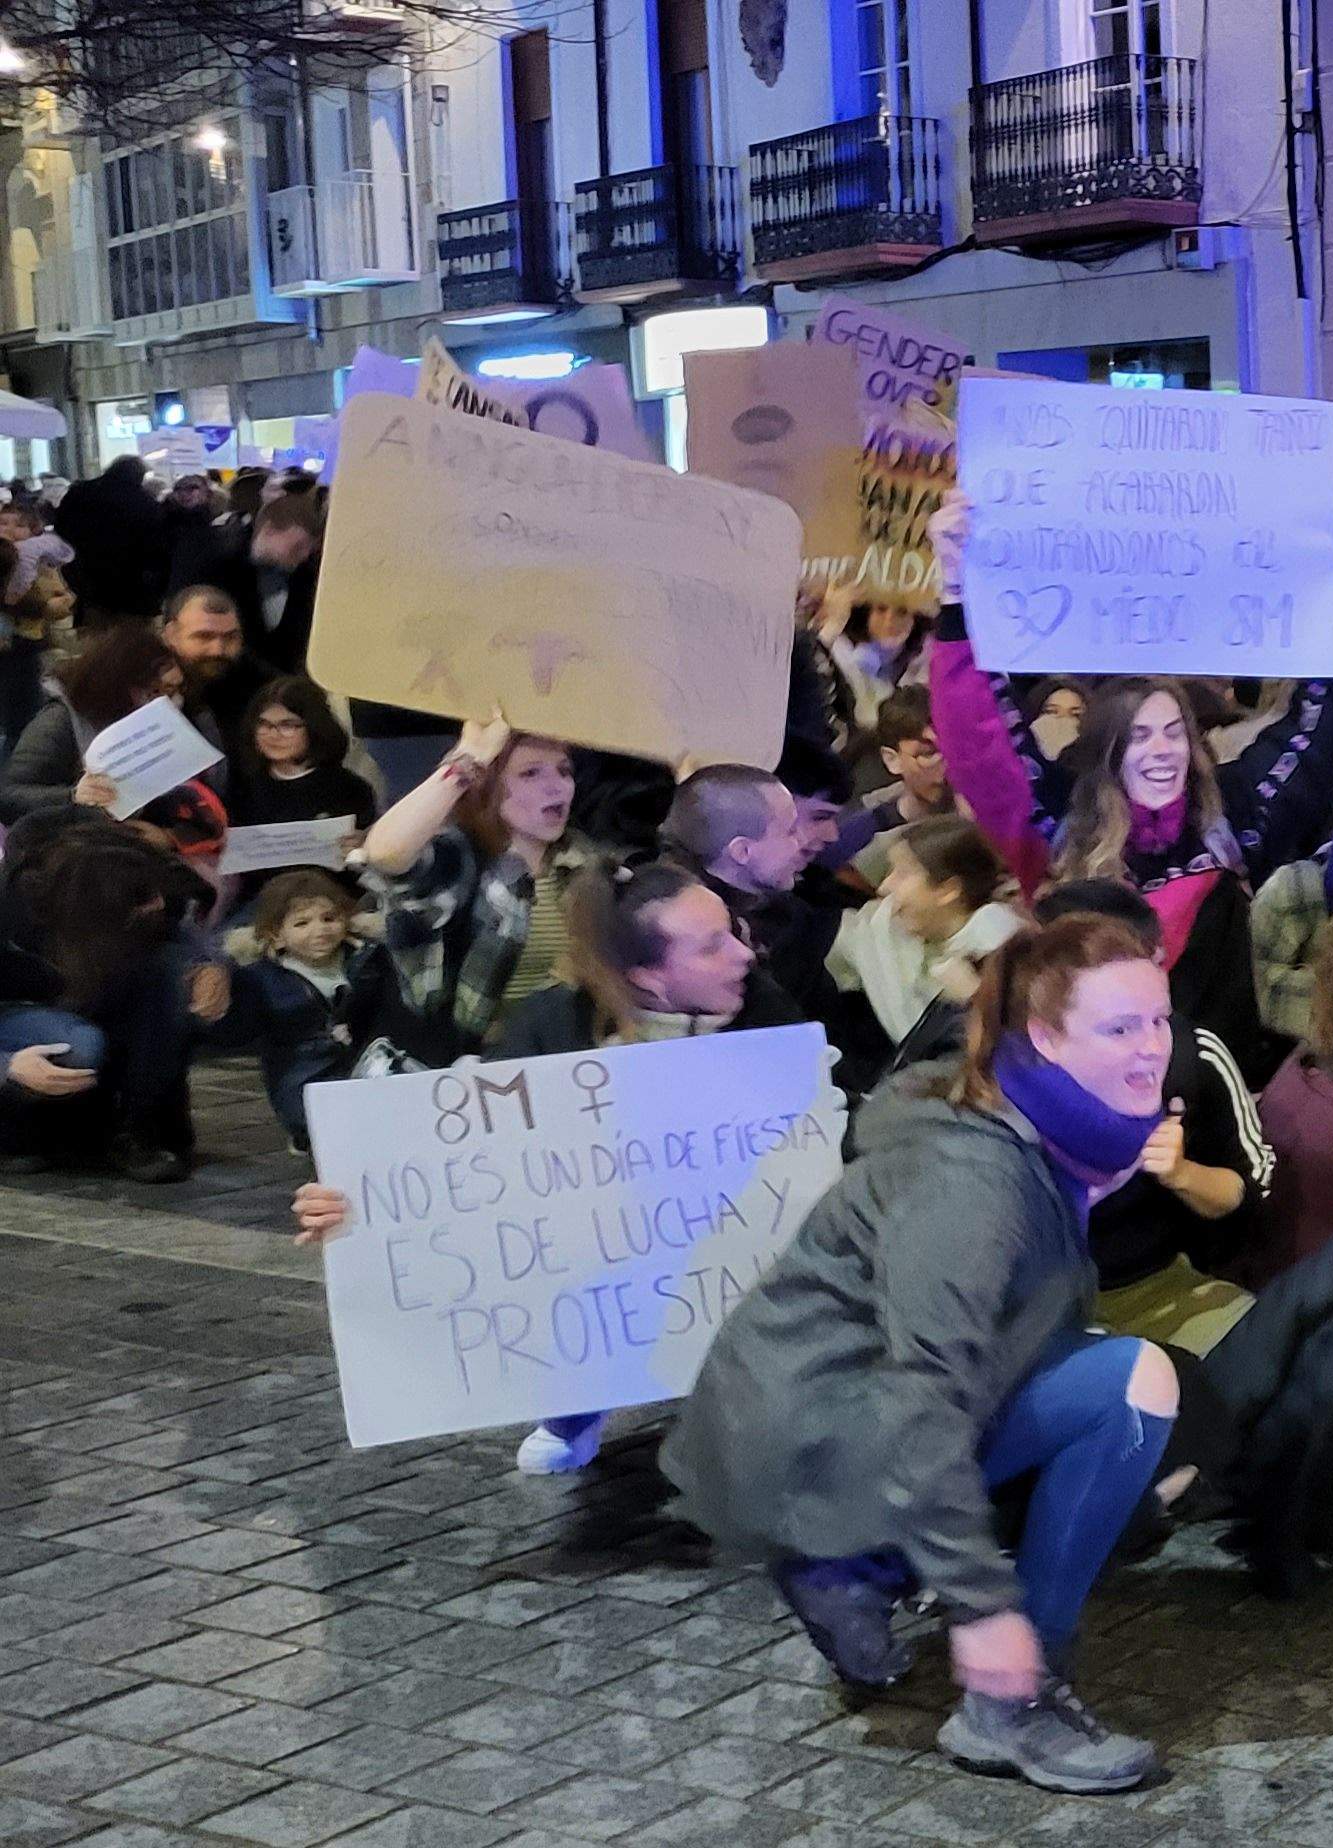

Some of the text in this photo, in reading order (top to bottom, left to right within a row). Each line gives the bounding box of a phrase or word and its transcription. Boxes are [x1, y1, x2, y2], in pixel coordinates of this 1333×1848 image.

[824, 309, 961, 385] GENDER
[1095, 401, 1230, 455] QUITARON
[1079, 468, 1239, 520] ACABARON
[1222, 592, 1295, 648] 8M
[431, 1068, 534, 1144] 8M
[361, 1159, 433, 1227] NO
[445, 1152, 506, 1213] ES
[523, 1147, 580, 1198] UN
[592, 1130, 655, 1184] DÍA
[664, 1131, 699, 1171] DE
[386, 1177, 792, 1312] ES DE LUCHA Y
[439, 1253, 760, 1395] PROTESTA
